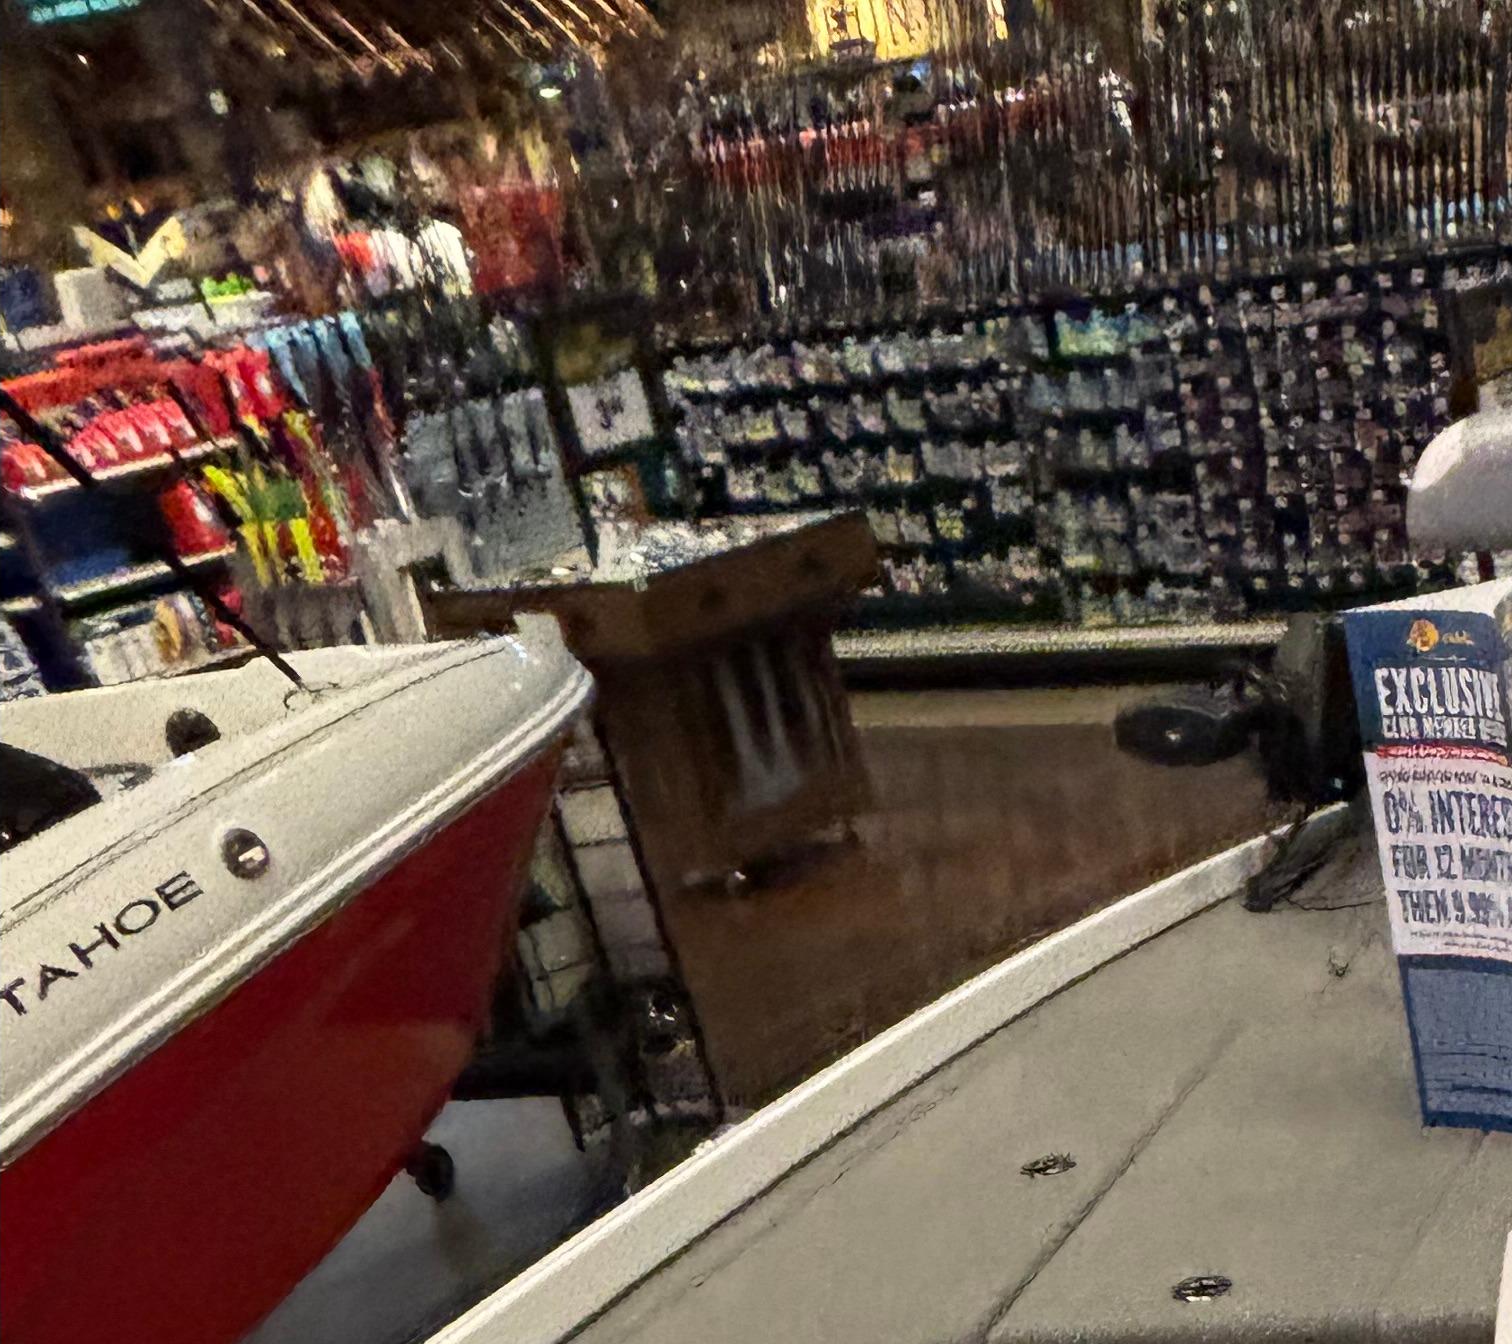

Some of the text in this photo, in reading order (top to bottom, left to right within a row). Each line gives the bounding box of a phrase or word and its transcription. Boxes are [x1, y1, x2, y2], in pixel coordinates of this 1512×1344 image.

[1390, 843, 1432, 881] FOR
[1434, 844, 1458, 880] 12
[0, 870, 205, 1016] TAHOE
